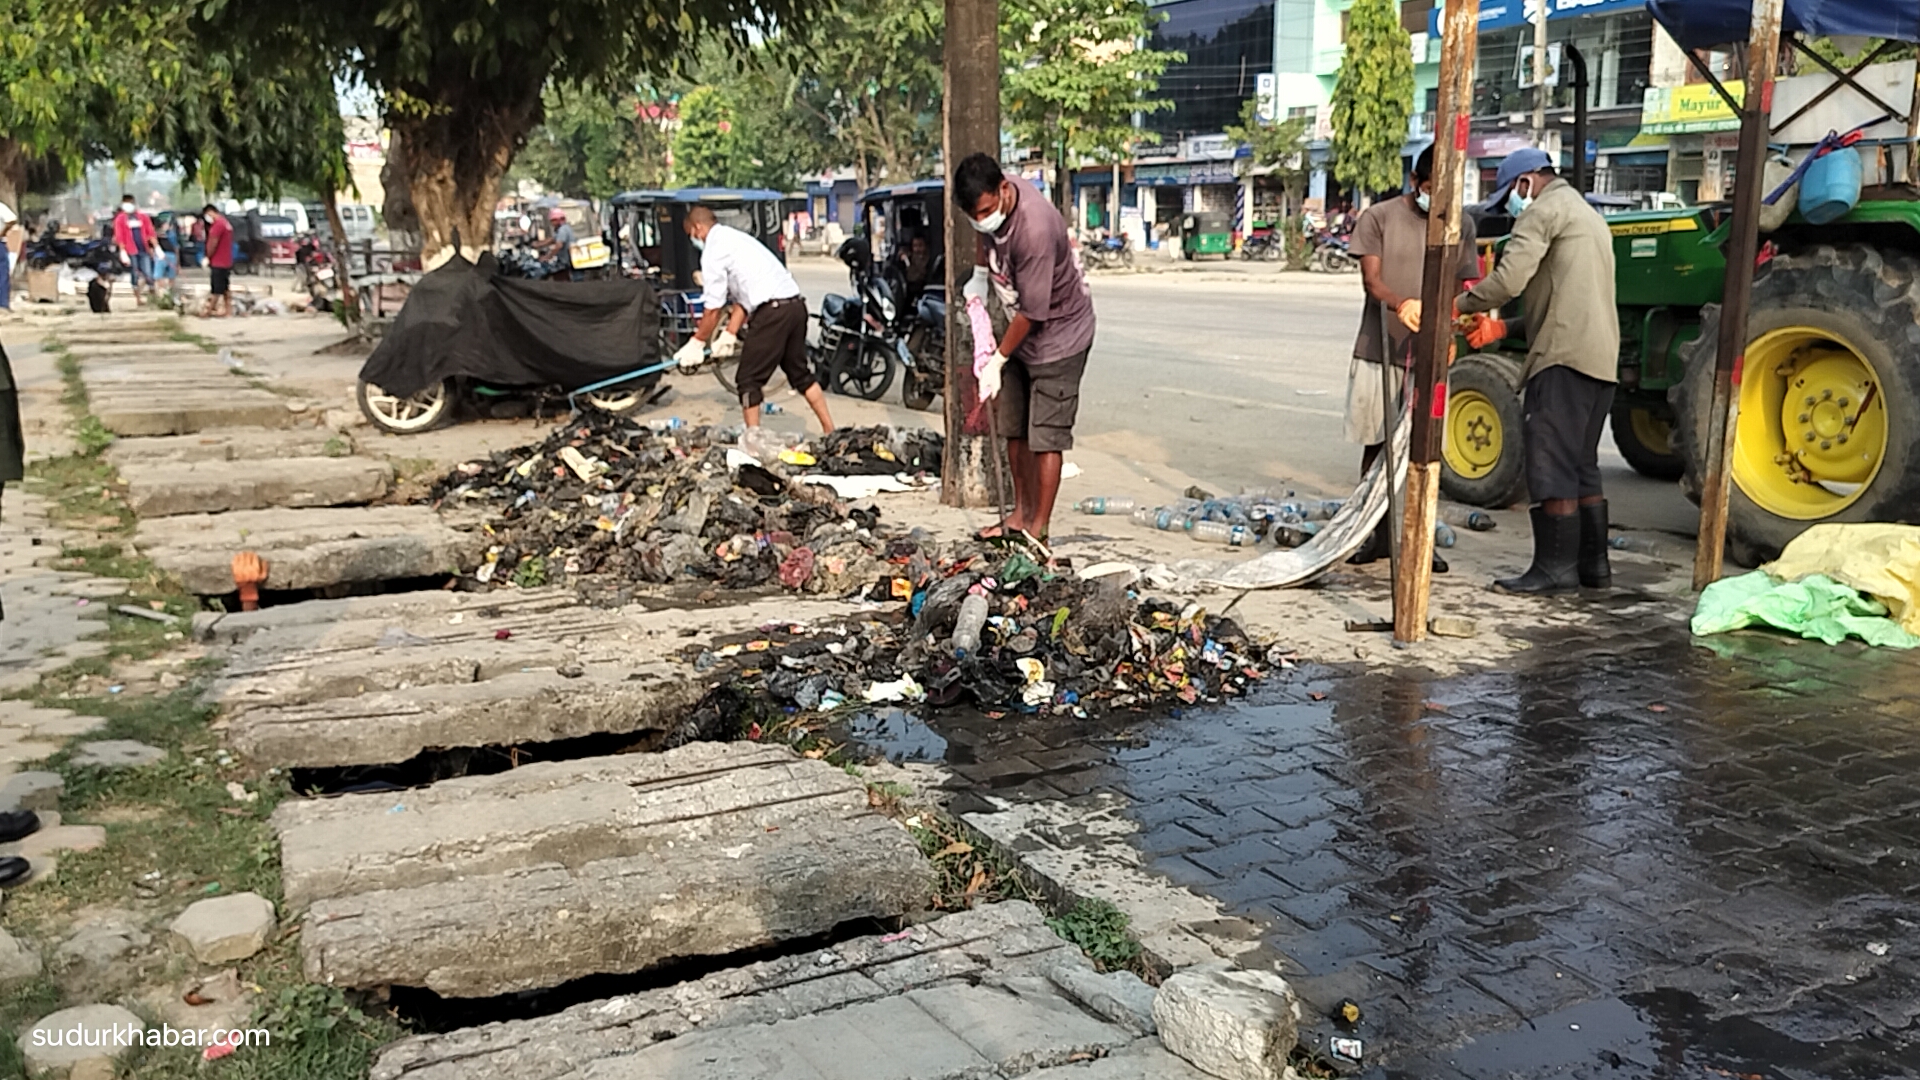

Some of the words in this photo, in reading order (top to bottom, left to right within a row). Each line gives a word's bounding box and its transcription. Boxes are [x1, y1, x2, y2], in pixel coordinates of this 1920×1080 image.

[1679, 98, 1722, 114] Mayur
[1611, 227, 1631, 236] OHN
[1631, 224, 1662, 235] DEERE
